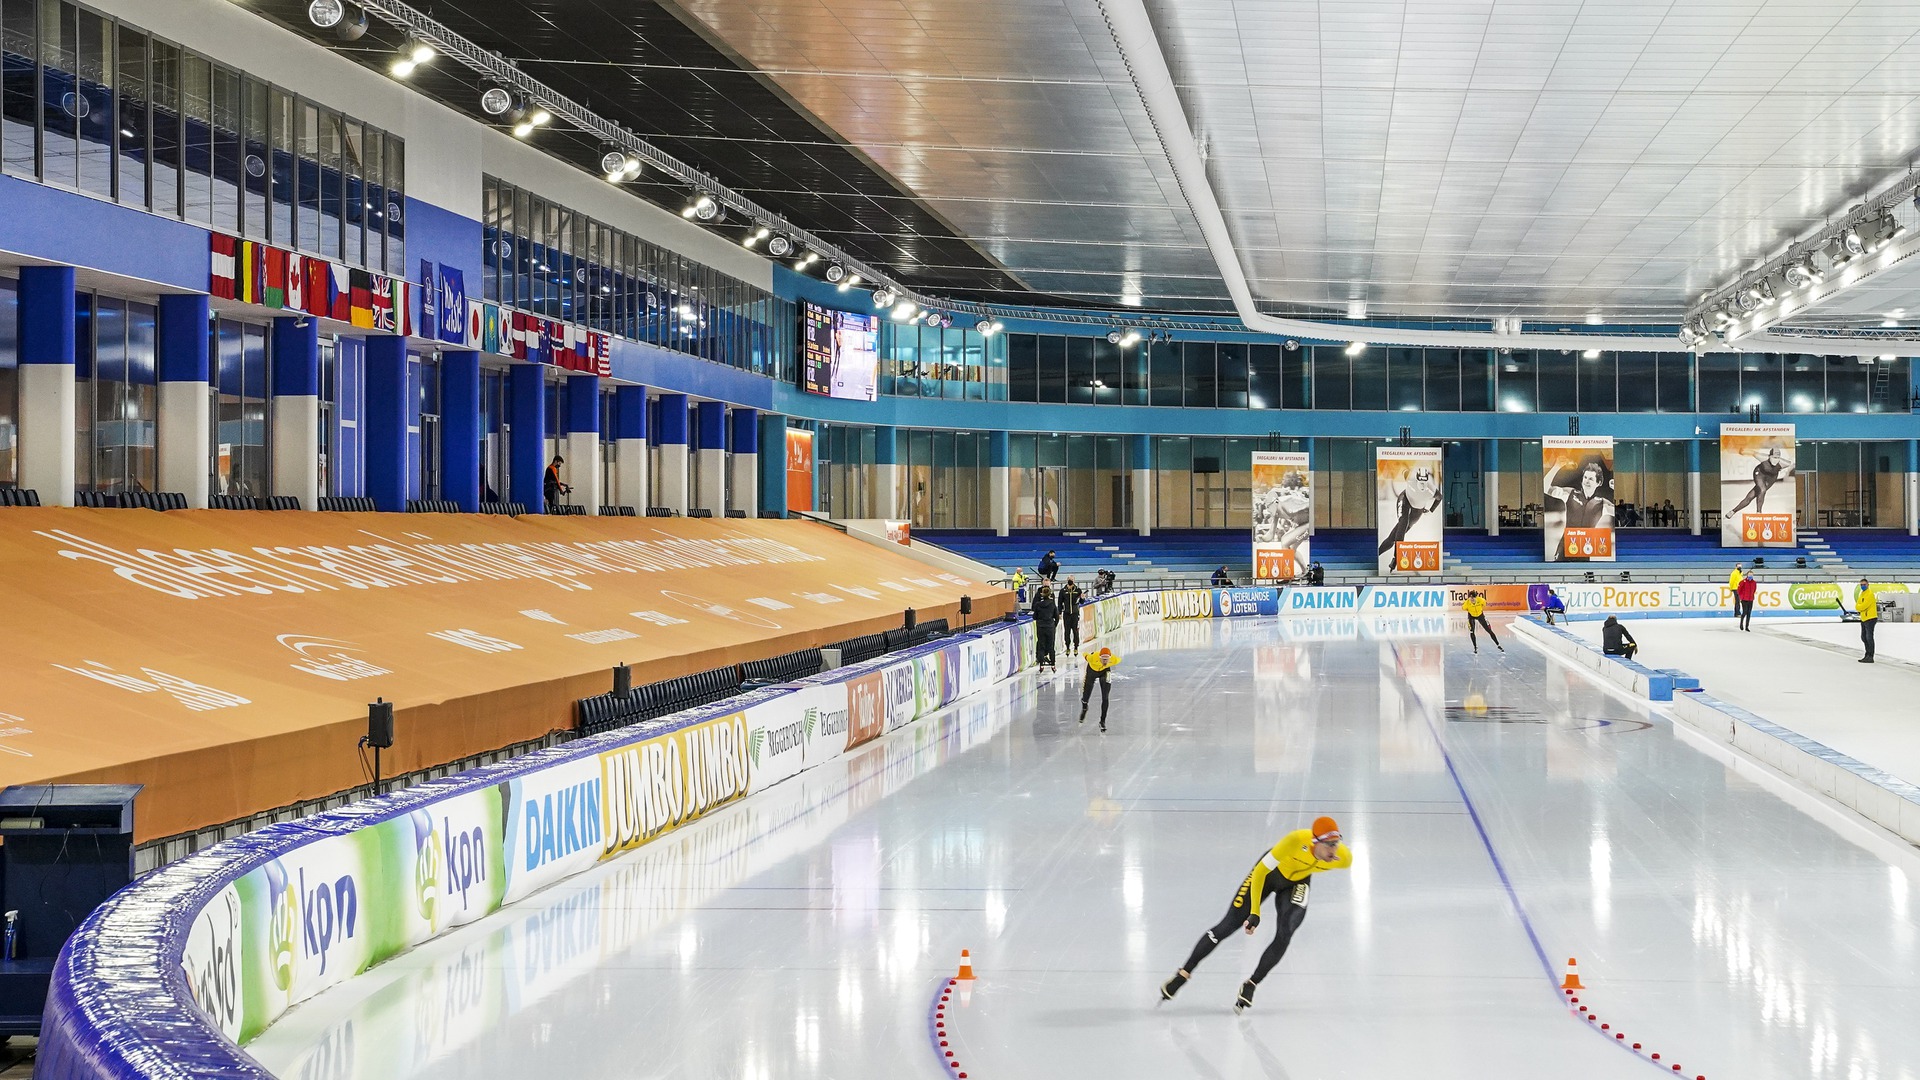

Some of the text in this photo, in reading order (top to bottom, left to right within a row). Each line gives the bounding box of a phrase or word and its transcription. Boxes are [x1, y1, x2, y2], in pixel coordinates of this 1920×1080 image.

[32, 529, 340, 600] alleen
[252, 545, 482, 591] samen
[1165, 591, 1212, 619] JUMBO
[1232, 590, 1270, 602] NEDERLANDSE
[1292, 591, 1354, 609] DAIKIN
[1373, 591, 1444, 608] DAIKIN
[1668, 586, 1781, 608] EuroPcs
[1793, 588, 1839, 606] Campina
[684, 716, 751, 821] JUMBO
[605, 736, 684, 855] JUMBO
[525, 776, 601, 873] DAIKIN
[444, 816, 486, 911] kpn
[298, 866, 358, 976] kpn
